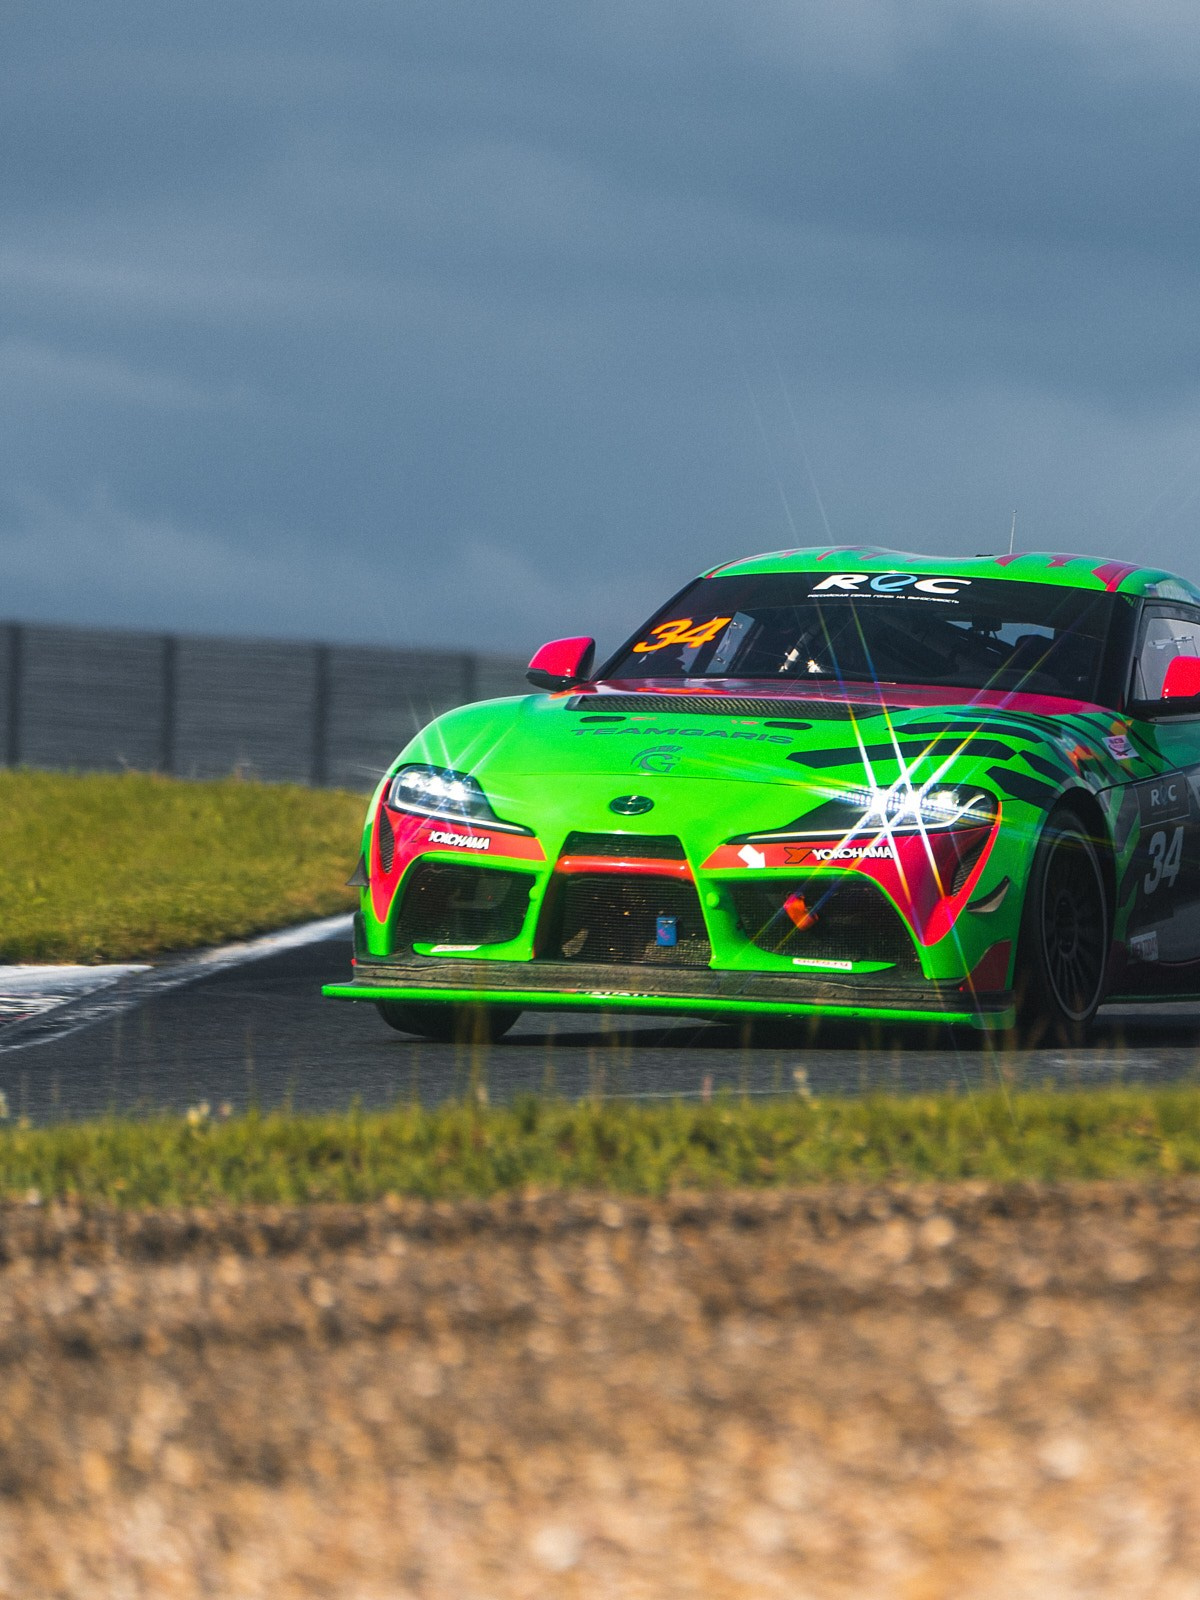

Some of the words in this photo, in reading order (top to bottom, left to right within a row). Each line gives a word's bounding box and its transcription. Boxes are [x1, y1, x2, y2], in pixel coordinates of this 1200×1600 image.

[632, 617, 732, 653] 34
[570, 727, 795, 744] TEAMGARIS
[428, 830, 491, 850] YOKOHAMA
[811, 846, 896, 861] YOKOHAMA
[1143, 825, 1184, 895] 34
